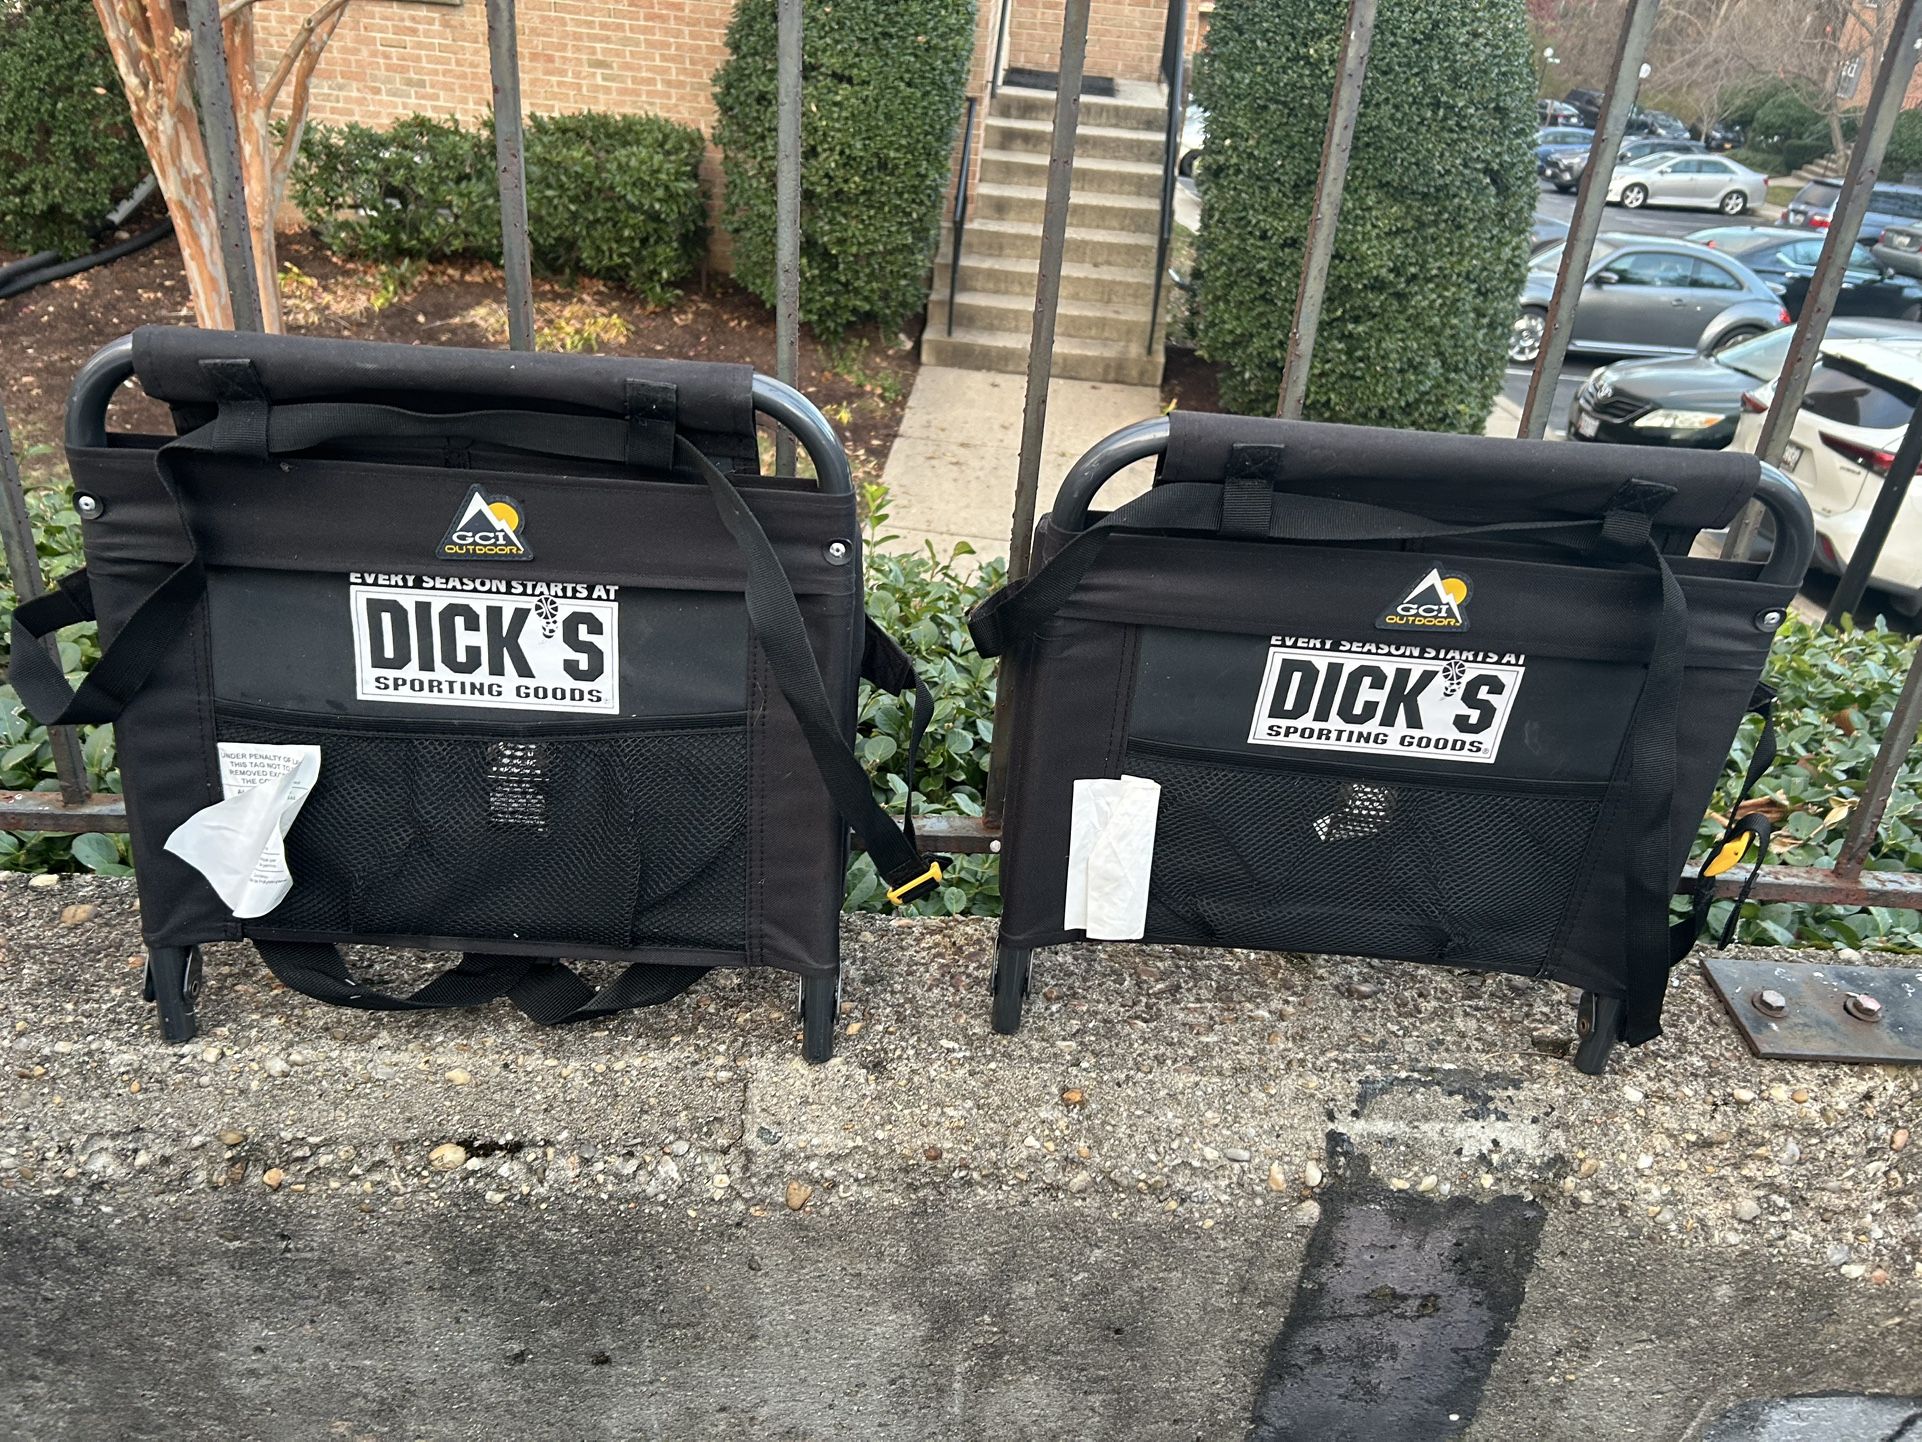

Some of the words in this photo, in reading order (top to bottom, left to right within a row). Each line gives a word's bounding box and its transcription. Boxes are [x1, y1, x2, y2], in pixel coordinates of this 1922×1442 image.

[452, 531, 507, 545] GCI
[444, 544, 517, 555] OUTDOOR
[350, 572, 416, 587] EVERY
[422, 575, 507, 594] SEASON
[510, 580, 590, 598] STARTS
[592, 584, 619, 600] AT
[1396, 603, 1450, 617] GCI
[1385, 615, 1456, 626] OUTDOOR
[366, 597, 604, 683] DICK'S
[1270, 635, 1333, 648] EVERY
[1338, 639, 1421, 657] SEASON
[374, 675, 503, 697] SPORTING
[515, 684, 603, 703] GOODS
[1267, 657, 1506, 735] DICK'S
[1266, 724, 1389, 745] SPORTING
[221, 752, 247, 760] UNDER
[248, 753, 282, 761] PENALTY
[229, 769, 268, 777] REMOVED
[230, 760, 248, 768] THIS
[248, 761, 266, 769] TAG
[282, 764, 291, 772] TO
[241, 777, 257, 785] THE
